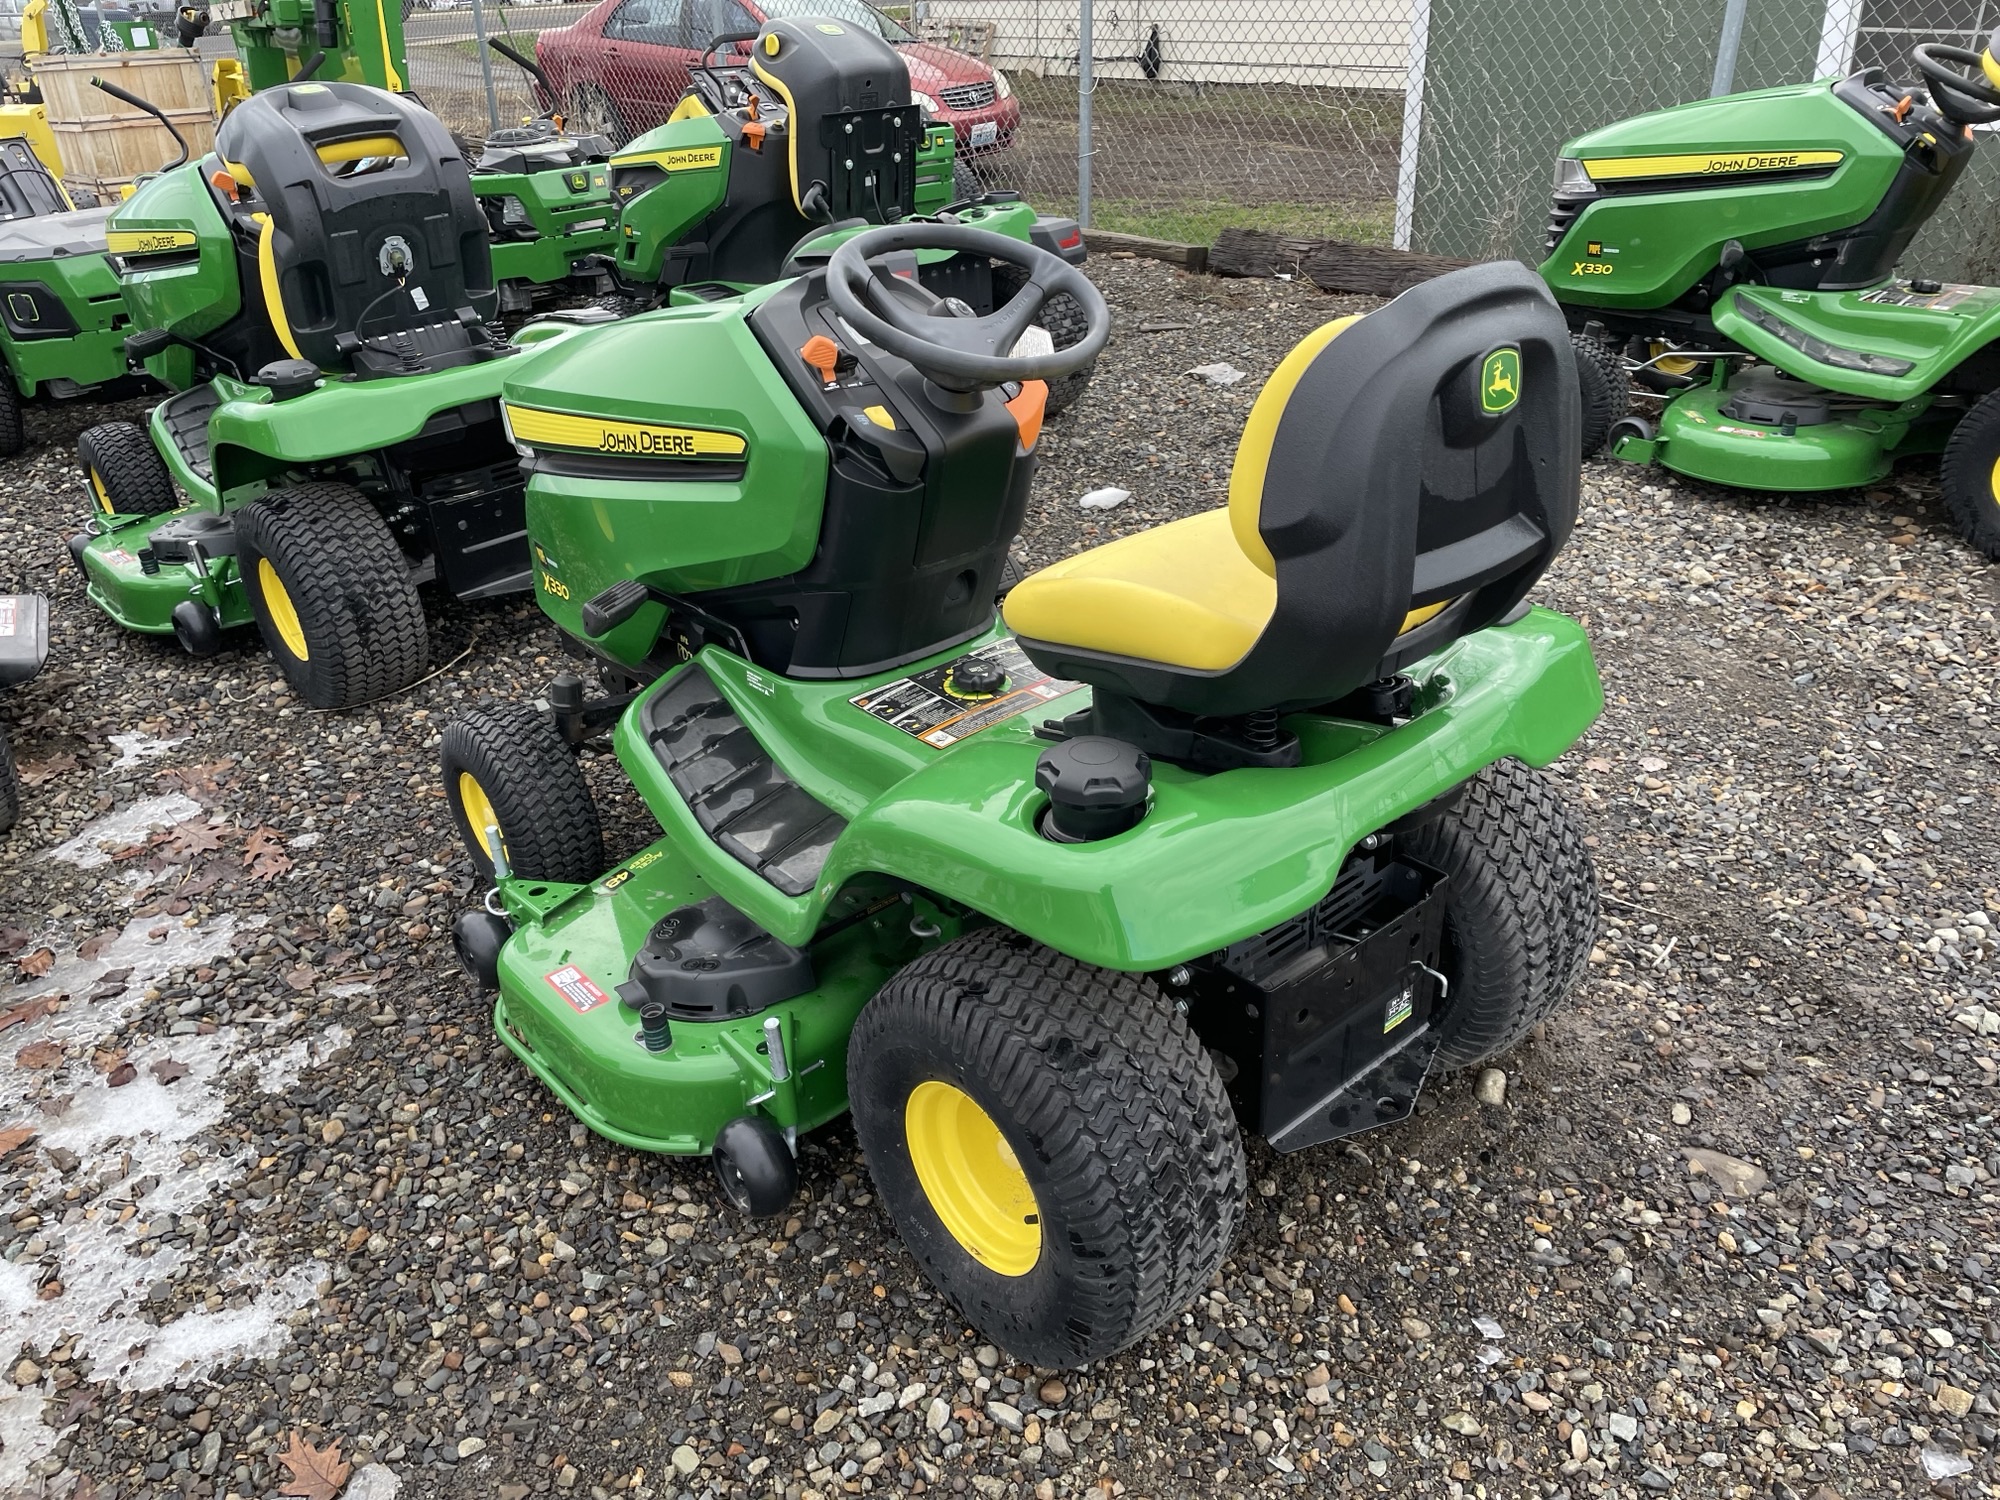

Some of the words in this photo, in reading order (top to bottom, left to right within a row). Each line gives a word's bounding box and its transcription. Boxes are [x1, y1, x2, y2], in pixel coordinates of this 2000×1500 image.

[667, 155, 687, 165] JOHN
[687, 153, 715, 163] DEERE
[1703, 159, 1744, 173] JOHN
[1747, 155, 1799, 170] DEERE
[138, 238, 153, 251] JOHN
[152, 235, 176, 249] DEERE
[1570, 262, 1613, 276] X330
[599, 429, 638, 451] JOHN
[640, 431, 695, 453] DEERE
[541, 571, 570, 600] X330
[605, 871, 629, 889] 48
